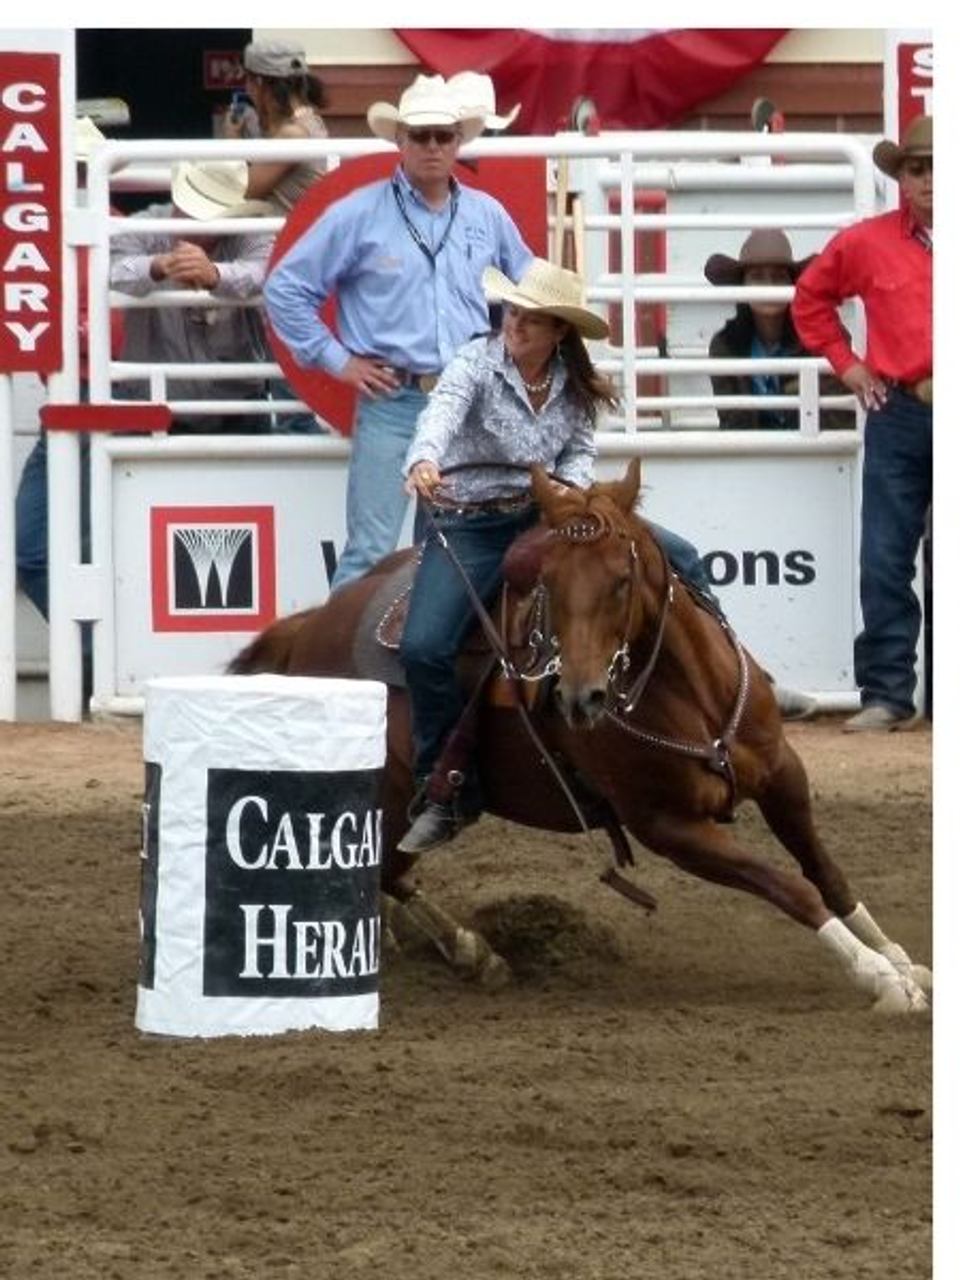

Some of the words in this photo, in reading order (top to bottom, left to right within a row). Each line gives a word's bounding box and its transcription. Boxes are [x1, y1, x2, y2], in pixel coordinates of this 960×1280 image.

[1, 82, 50, 351] CALGARY
[226, 795, 383, 870] CALGA
[238, 904, 381, 979] HERAL
